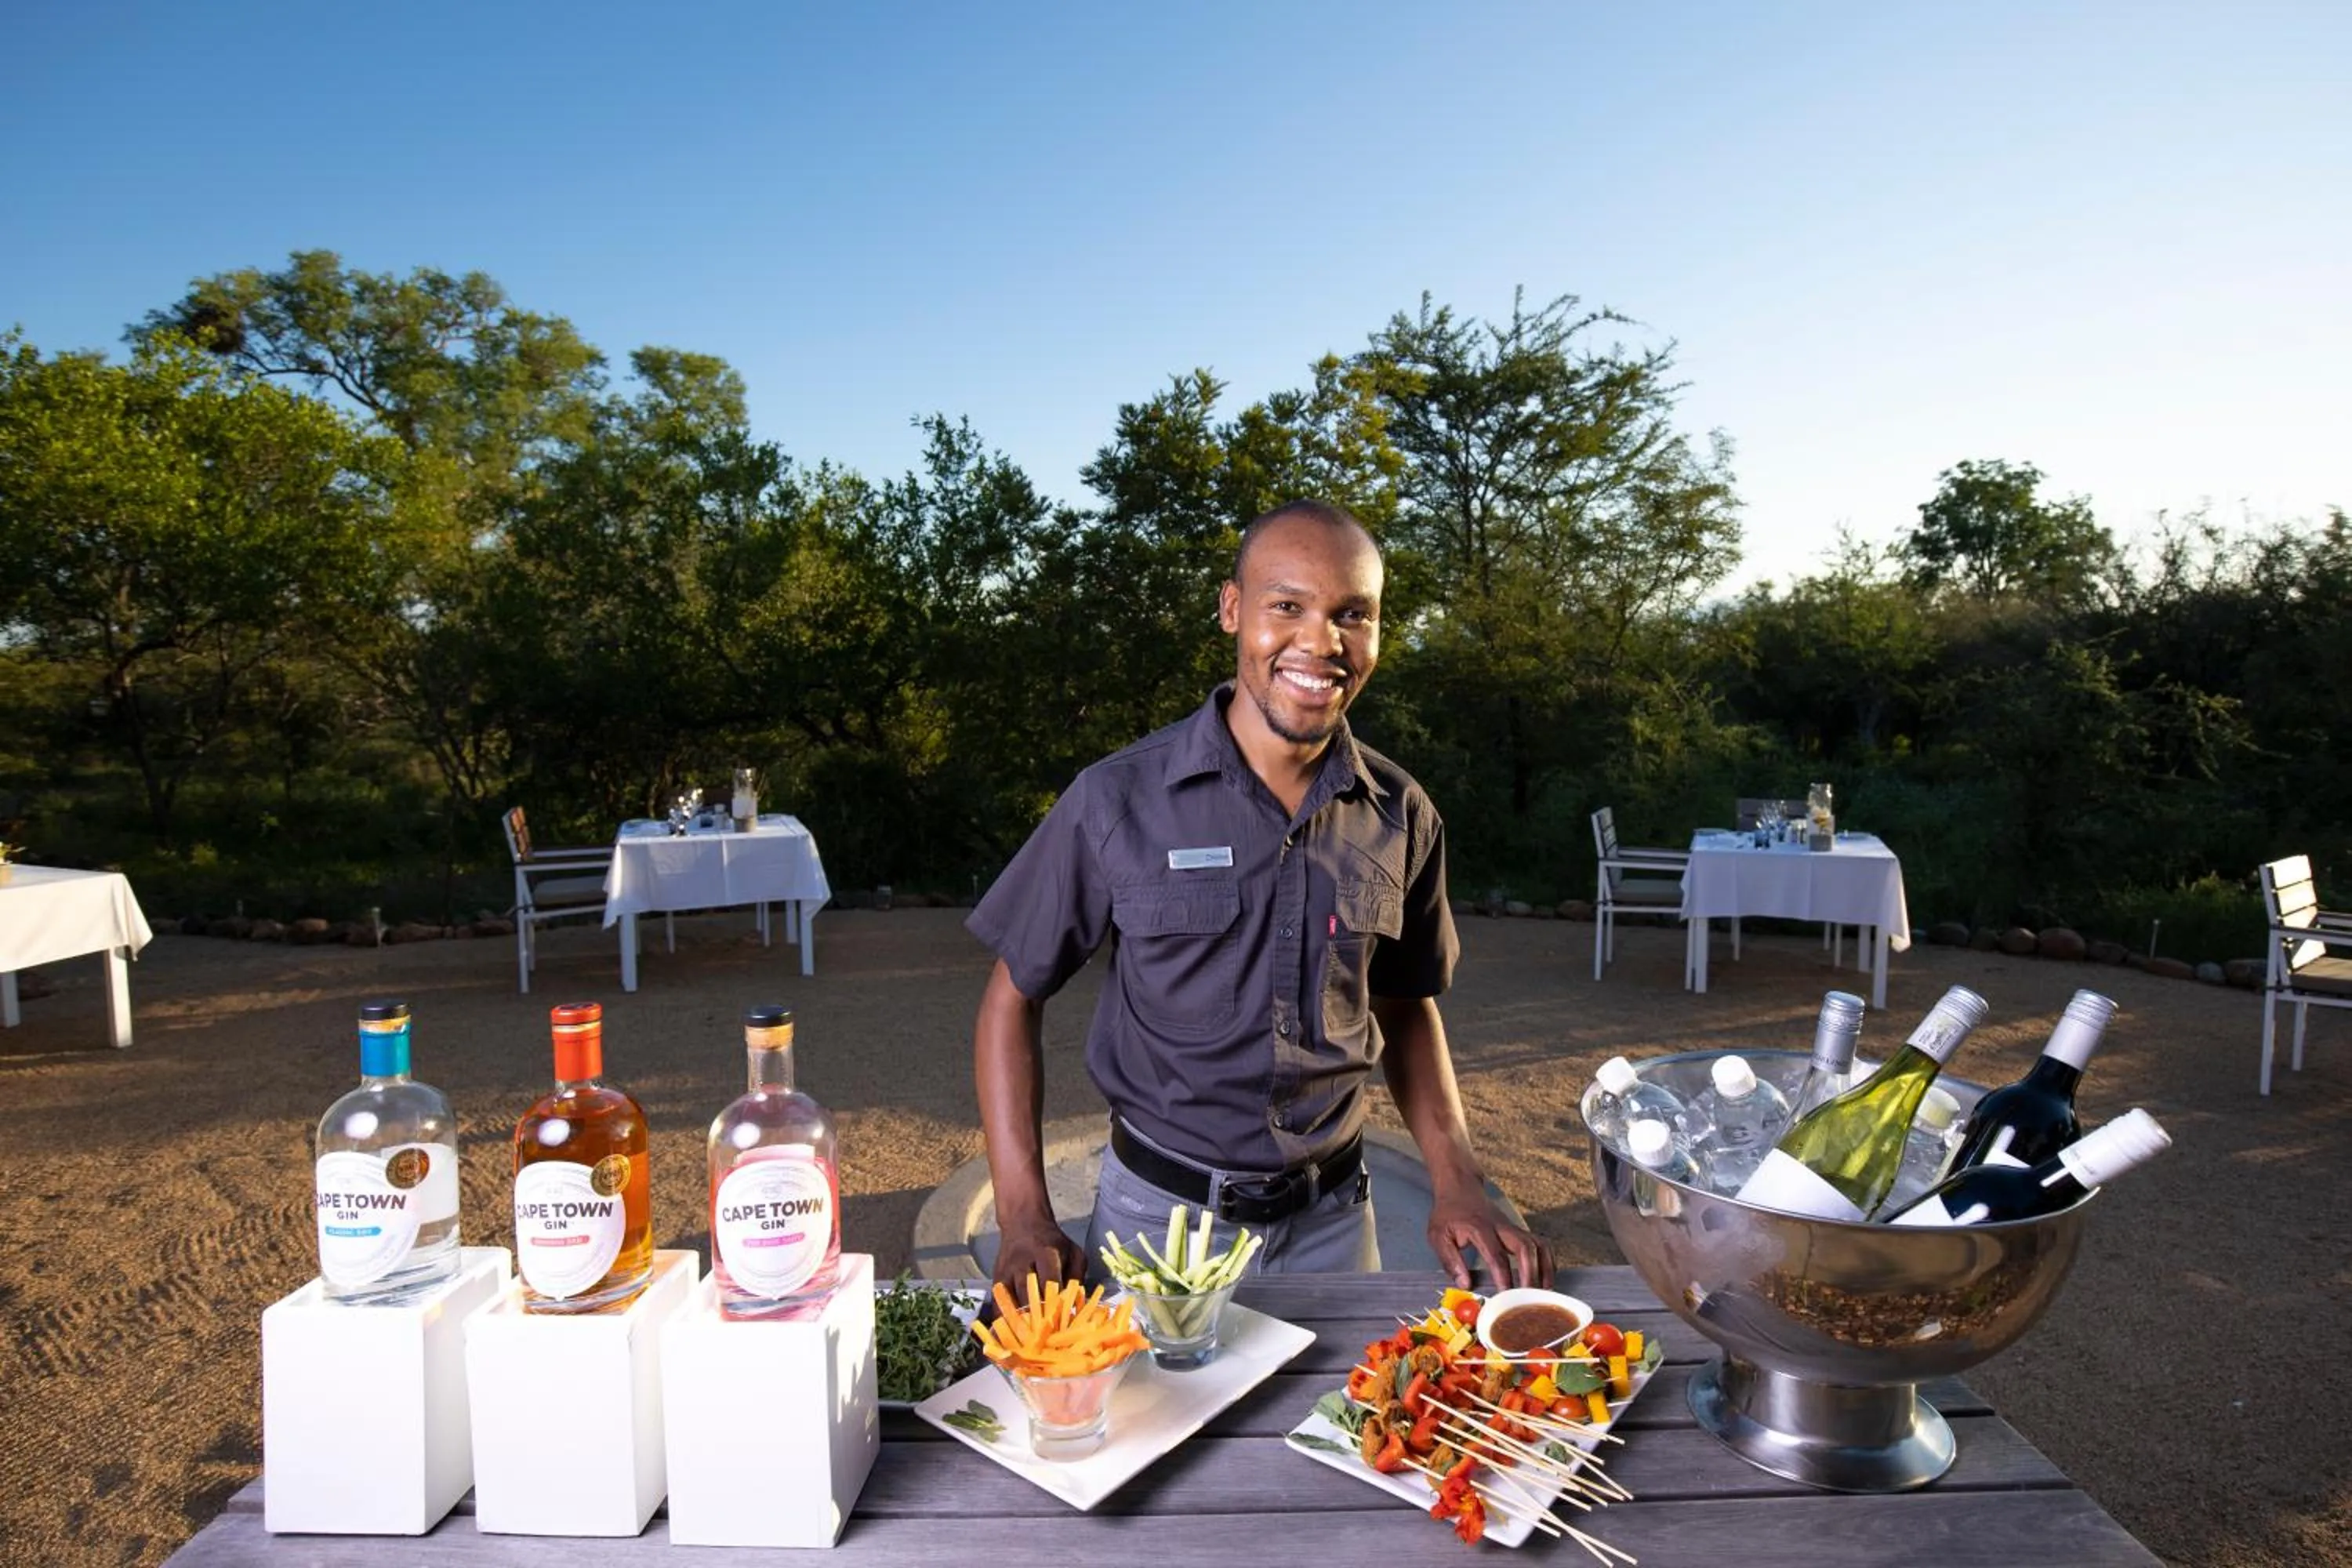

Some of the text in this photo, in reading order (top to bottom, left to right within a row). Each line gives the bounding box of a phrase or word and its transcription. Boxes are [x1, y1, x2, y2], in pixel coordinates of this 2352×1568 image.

[345, 1193, 407, 1210] TOWN
[336, 1210, 358, 1220] GIN
[552, 1201, 613, 1218] TOWN
[722, 1196, 824, 1222] CAPE TOWN
[544, 1221, 568, 1230] GIN
[760, 1219, 786, 1230] GIN
